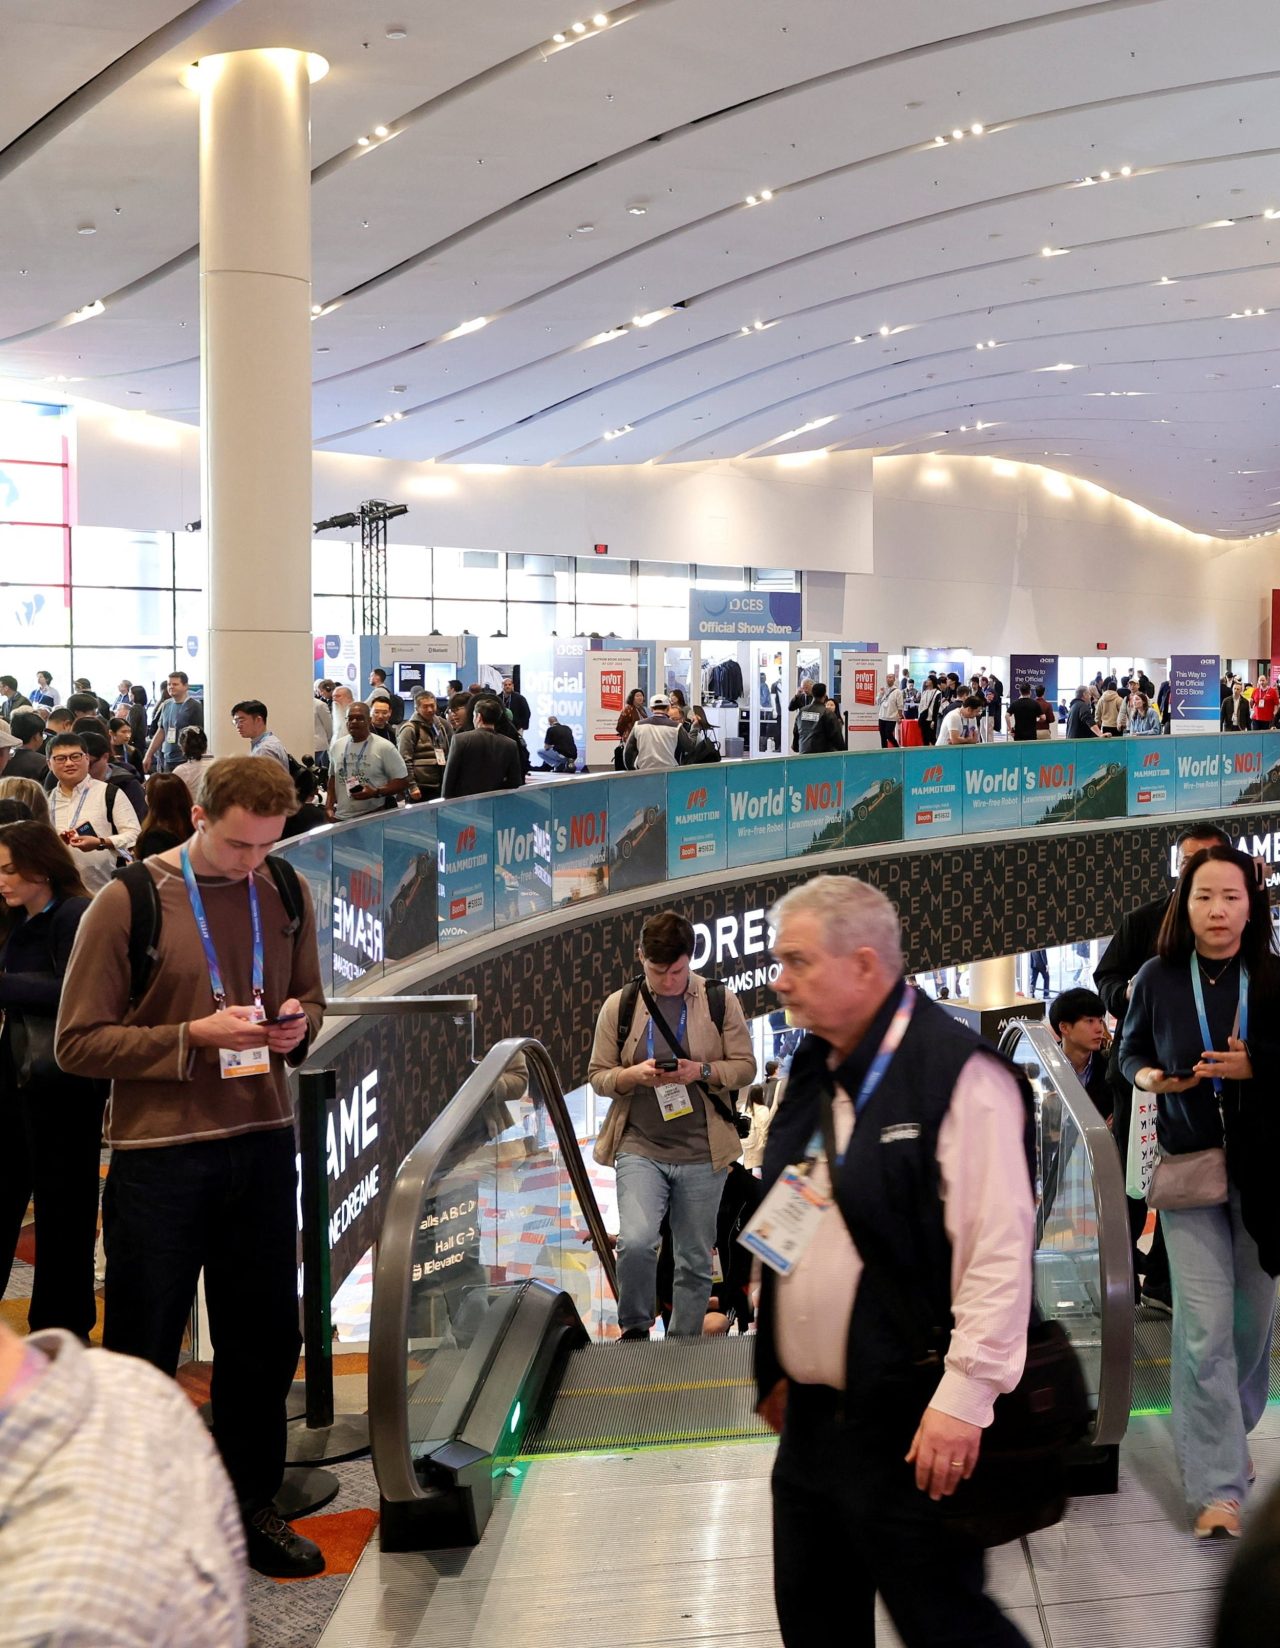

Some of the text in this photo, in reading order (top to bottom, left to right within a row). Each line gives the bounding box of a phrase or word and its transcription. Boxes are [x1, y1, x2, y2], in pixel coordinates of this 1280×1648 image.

[741, 599, 764, 611] CES
[699, 621, 792, 634] Official Show Store
[565, 644, 583, 656] CES
[856, 672, 874, 682] PIVOT
[1028, 668, 1041, 677] Way
[1188, 671, 1200, 679] Way
[602, 673, 622, 685] PIVOT
[1186, 679, 1204, 687] Official
[602, 685, 622, 694] OR DIE
[864, 683, 874, 691] DIE
[537, 694, 583, 716] Show
[1178, 752, 1262, 778] World's NO.1
[965, 764, 1074, 795] World's NO.1
[911, 784, 956, 795] MAMMOTION
[730, 781, 843, 822] World's NO.1
[1001, 797, 1018, 806] Robot
[675, 810, 720, 825] MAMMOTION
[917, 813, 931, 822] Booth
[570, 811, 607, 849] NO.1
[738, 824, 766, 838] Wire-free
[766, 822, 784, 833] Robot
[681, 846, 696, 857] Booth
[451, 903, 466, 915] Booth
[755, 967, 766, 987] IN
[419, 1215, 439, 1230] alls
[435, 1232, 466, 1254] Hall G
[424, 1251, 465, 1275] Elevator
